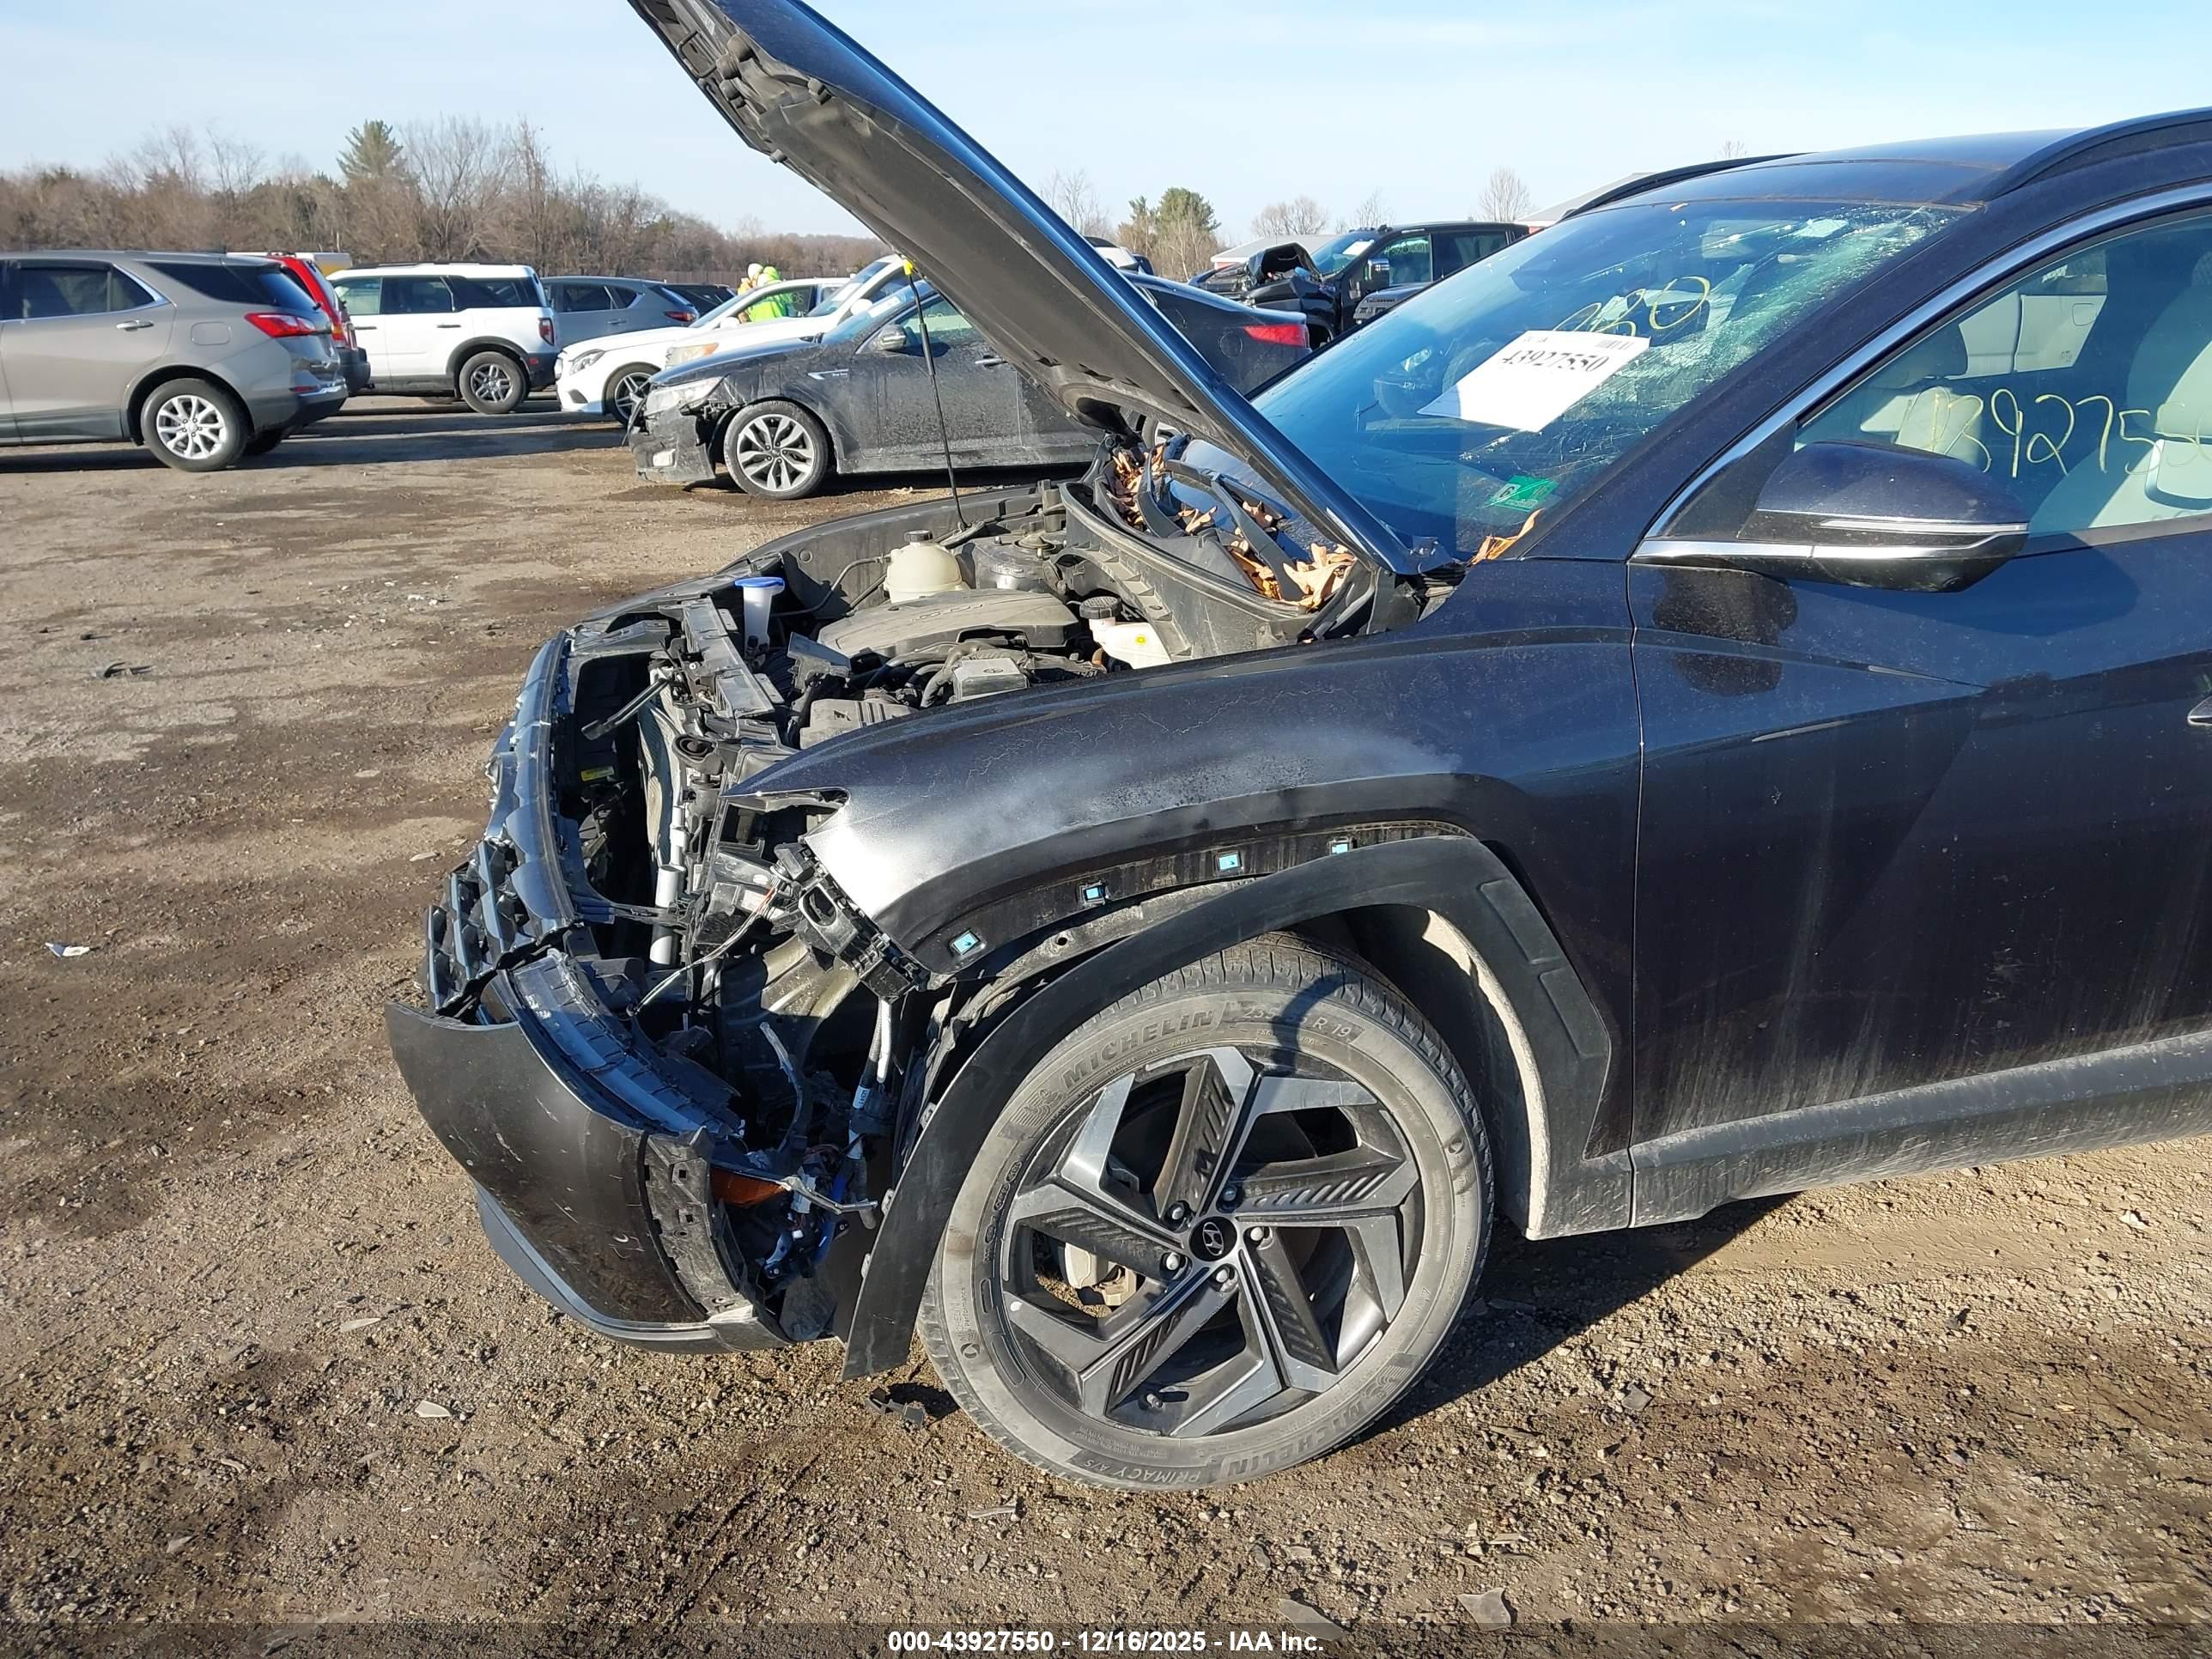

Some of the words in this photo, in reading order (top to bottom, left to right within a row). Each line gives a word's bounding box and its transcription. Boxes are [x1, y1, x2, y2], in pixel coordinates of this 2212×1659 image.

[1502, 349, 1610, 372] 43927550
[1312, 1016, 1328, 1030] R
[1331, 1023, 1352, 1039] 19
[1061, 1008, 1216, 1089] MICHELIN
[1227, 1401, 1367, 1477] MICHELIN
[1085, 1459, 1110, 1473] A/S
[1112, 1465, 1201, 1485] PRIMACY
